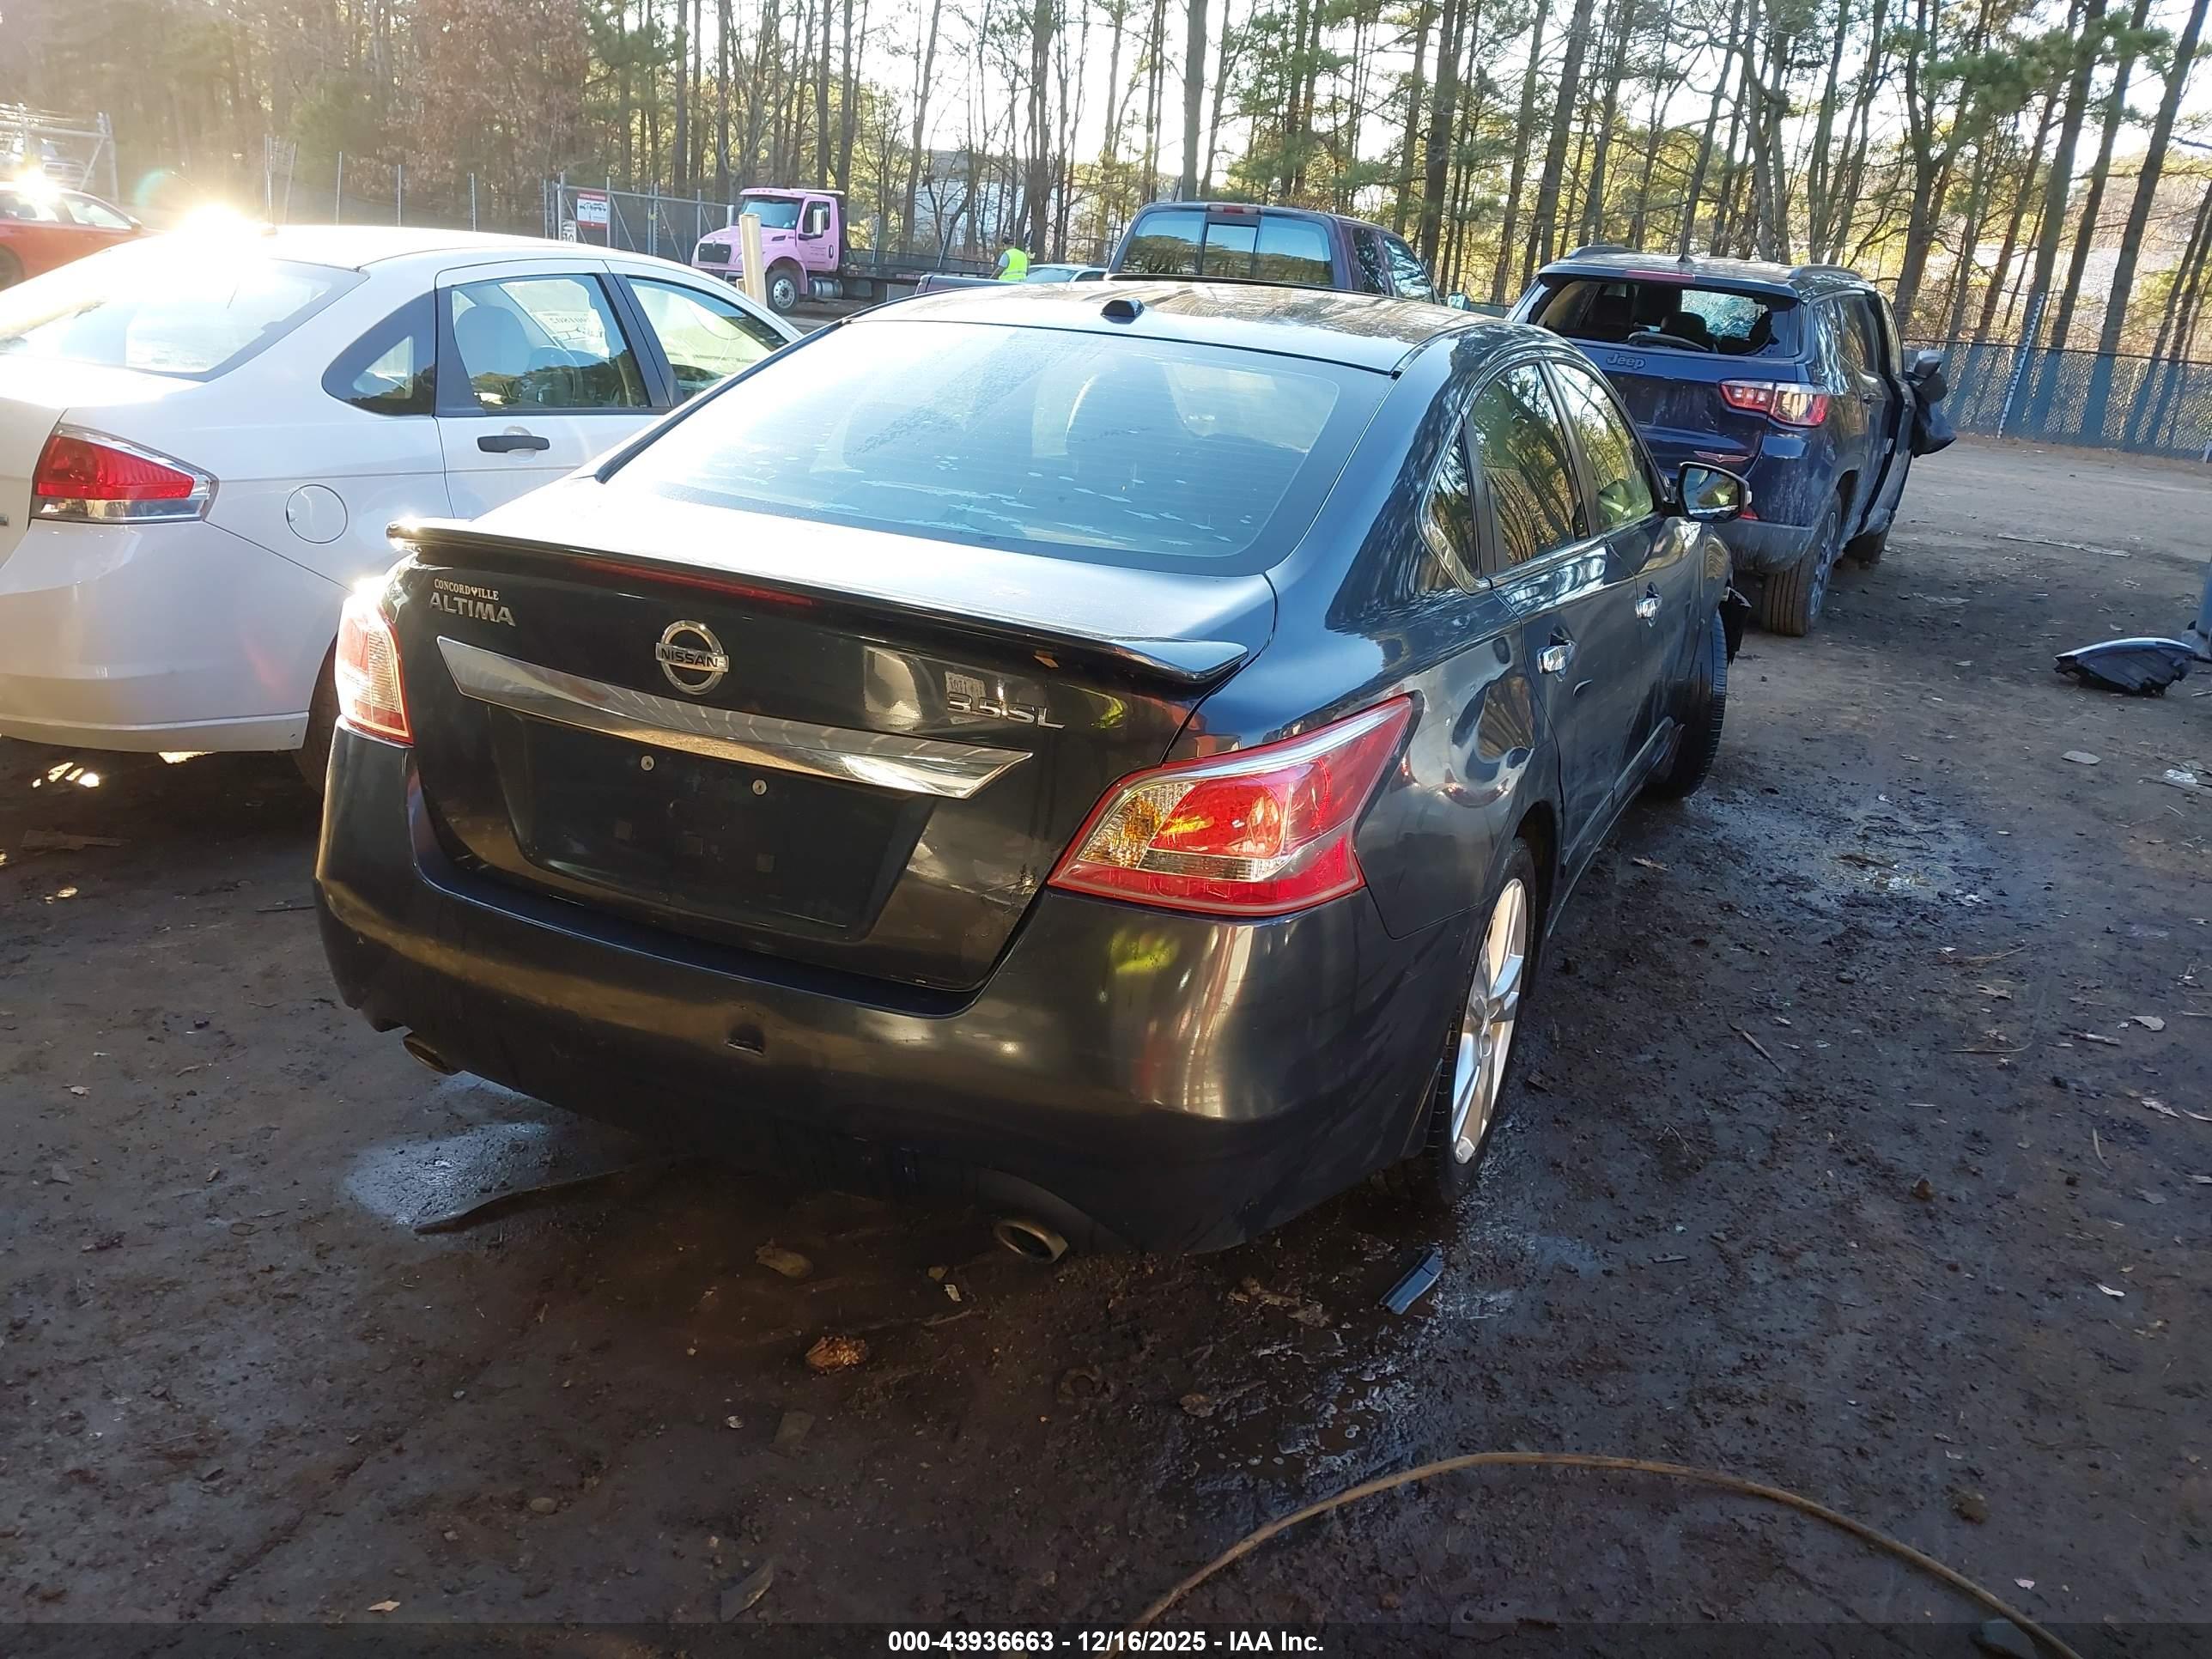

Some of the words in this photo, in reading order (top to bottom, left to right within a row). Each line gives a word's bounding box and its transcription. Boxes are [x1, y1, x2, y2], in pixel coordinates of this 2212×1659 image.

[1607, 352, 1645, 369] Jeep
[434, 578, 500, 601] CONCORDVILLE
[429, 592, 516, 627] ALTIMA
[660, 647, 719, 668] NISSAN
